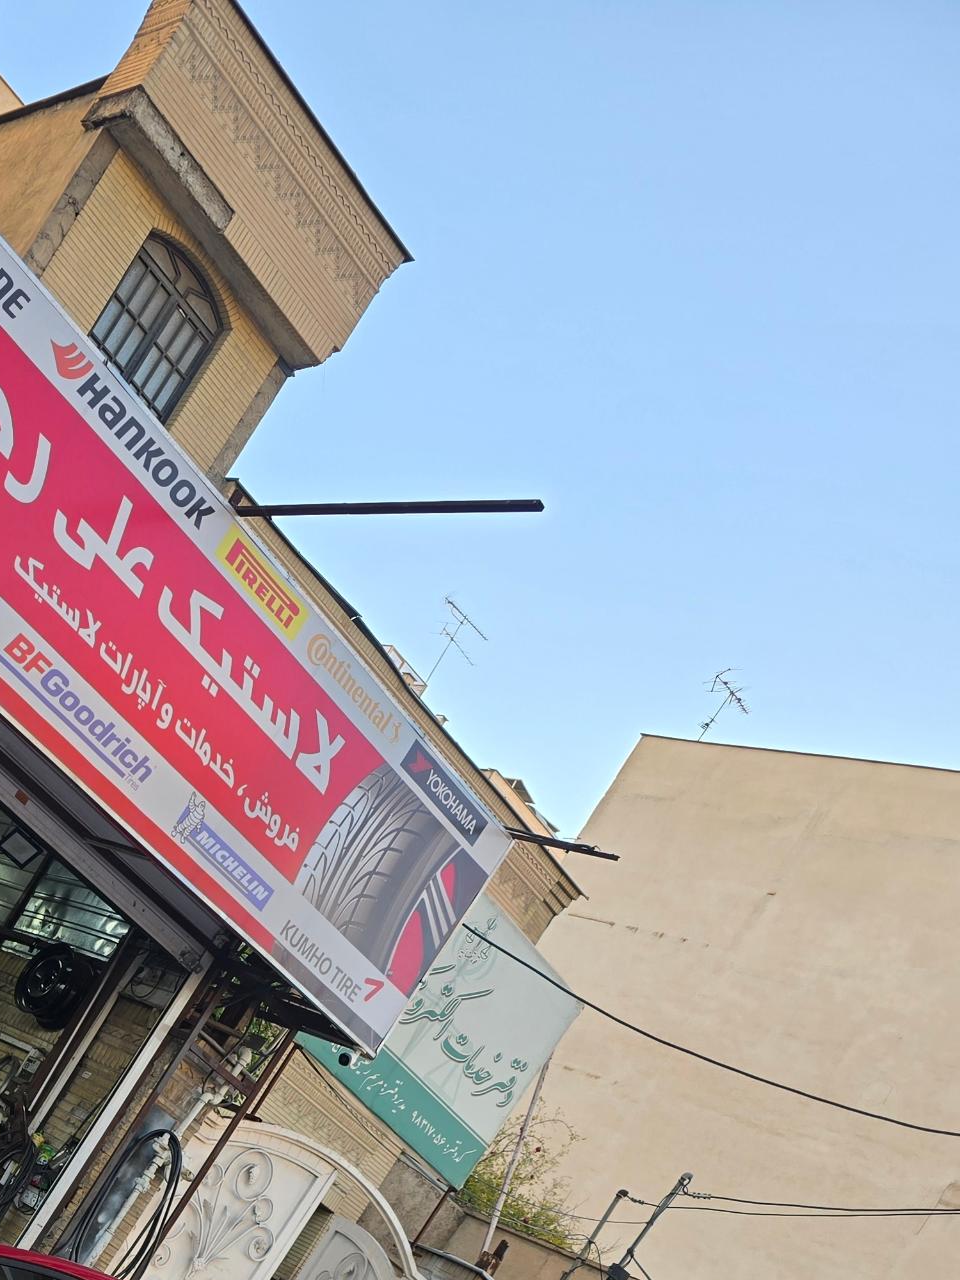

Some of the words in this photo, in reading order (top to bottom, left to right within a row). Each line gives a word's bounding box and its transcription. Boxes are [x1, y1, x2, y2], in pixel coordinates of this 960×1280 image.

[53, 495, 155, 598] علی
[225, 537, 303, 629] PIRELLI
[13, 554, 102, 648] لاستیک
[3, 637, 155, 783] BFGoodrich
[99, 636, 168, 714] آپارات
[158, 585, 346, 796] لاستیک
[307, 633, 392, 745] Continental
[174, 715, 236, 790] خدمات
[425, 768, 478, 836] YOKOHAMA
[195, 830, 269, 903] MICHELIN
[279, 918, 332, 975] KUMHO
[331, 963, 362, 1003] TIRE
[440, 1033, 502, 1085] خدمات
[471, 1057, 528, 1107] دفتر
